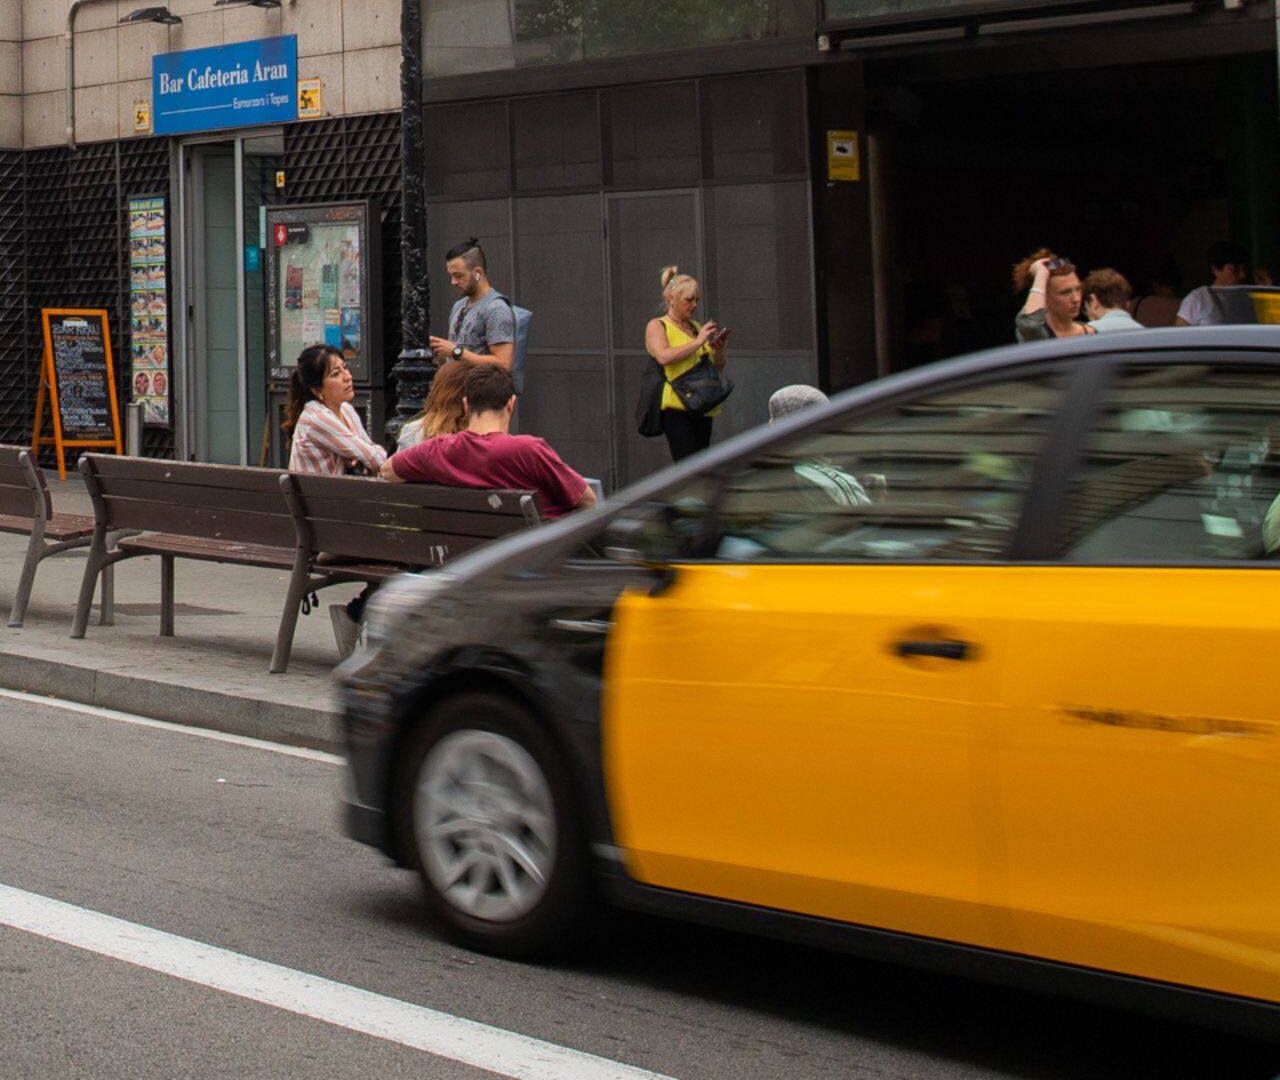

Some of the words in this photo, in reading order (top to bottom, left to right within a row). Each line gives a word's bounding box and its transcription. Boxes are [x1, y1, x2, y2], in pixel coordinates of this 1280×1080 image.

[159, 73, 185, 95] Bar
[187, 63, 249, 91] Cafeteria
[253, 60, 288, 83] Aran
[271, 93, 289, 107] Tapes
